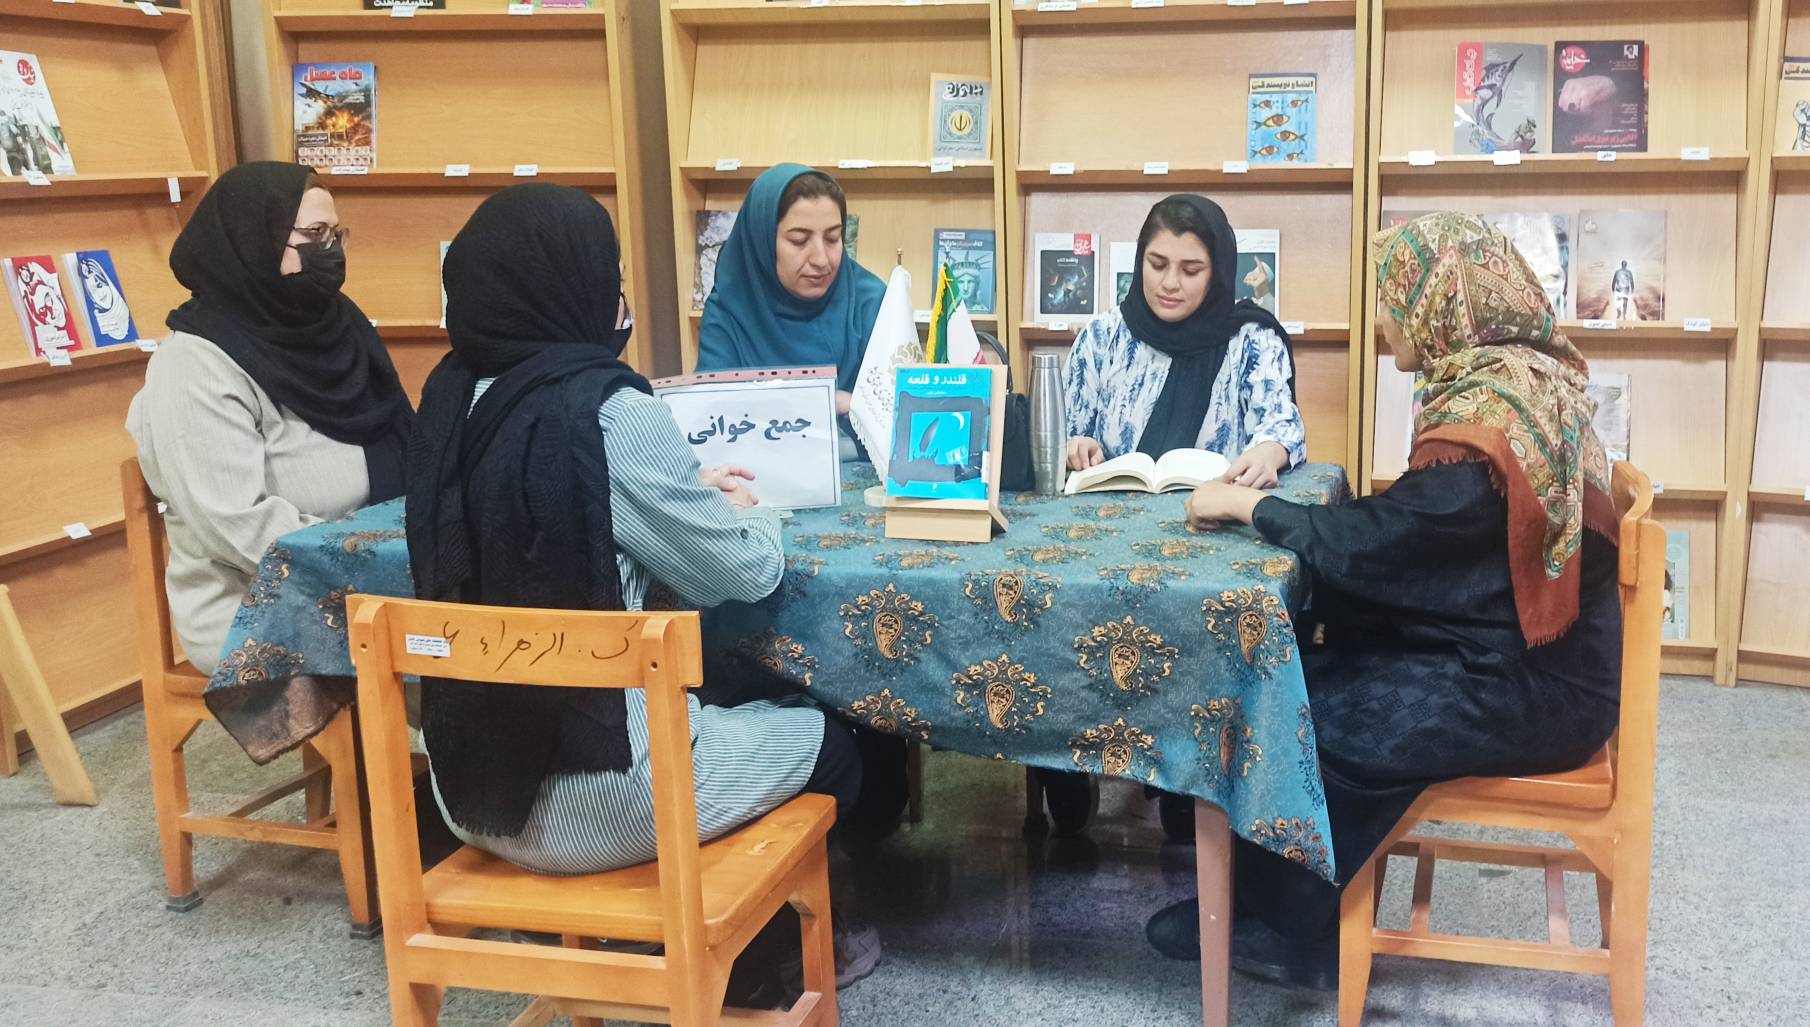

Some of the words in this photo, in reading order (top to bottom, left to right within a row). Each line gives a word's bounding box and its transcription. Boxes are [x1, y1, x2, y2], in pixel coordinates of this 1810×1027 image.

[303, 66, 336, 82] عسل
[338, 65, 363, 80] ماه
[907, 373, 930, 385] قلعه
[933, 375, 939, 385] و
[941, 373, 967, 385] قلندر
[687, 412, 756, 445] خوانی
[764, 417, 812, 441] جمع
